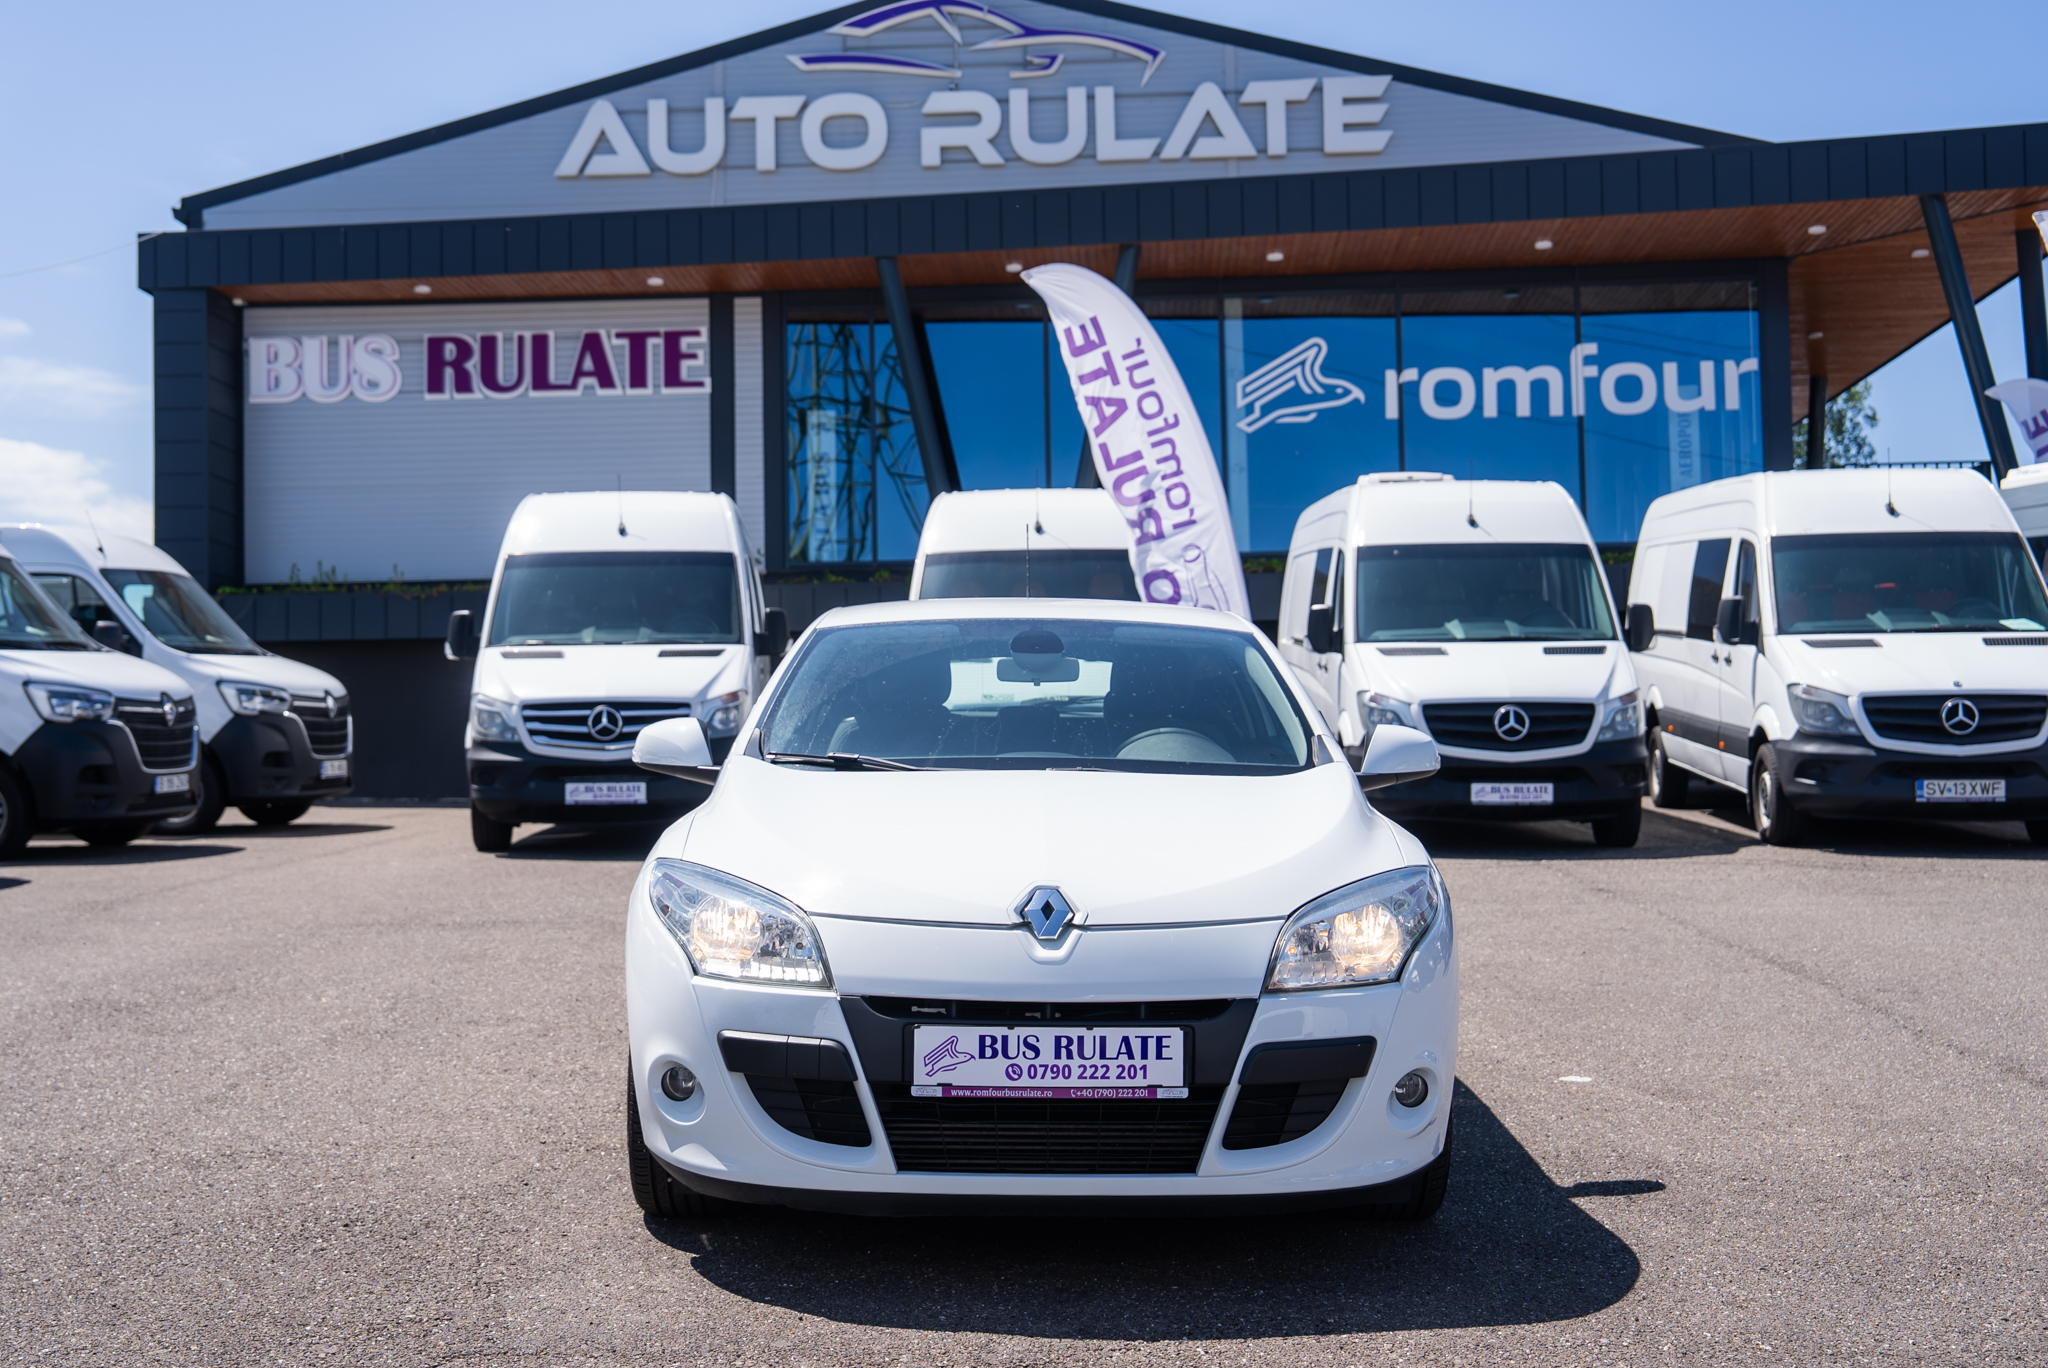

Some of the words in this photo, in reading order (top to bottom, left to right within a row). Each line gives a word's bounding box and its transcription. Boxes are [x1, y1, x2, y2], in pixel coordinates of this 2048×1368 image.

[554, 92, 890, 179] AUTO
[919, 74, 1395, 169] RULATE
[247, 335, 402, 404] BUS
[424, 327, 712, 400] RULATE
[1384, 342, 1759, 421] romfour
[1677, 410, 1693, 479] AEROPO
[1925, 781, 1947, 796] SV
[977, 1034, 1041, 1061] BUS
[1053, 1034, 1173, 1061] RULATE
[1027, 1063, 1072, 1081] 0790
[1077, 1063, 1111, 1081] 222
[1115, 1063, 1148, 1081] 201
[950, 1087, 1053, 1099] www.romfourbusrulate.ro
[1094, 1087, 1117, 1099] (790)
[1117, 1087, 1133, 1098] 222
[1133, 1087, 1149, 1098] 201
